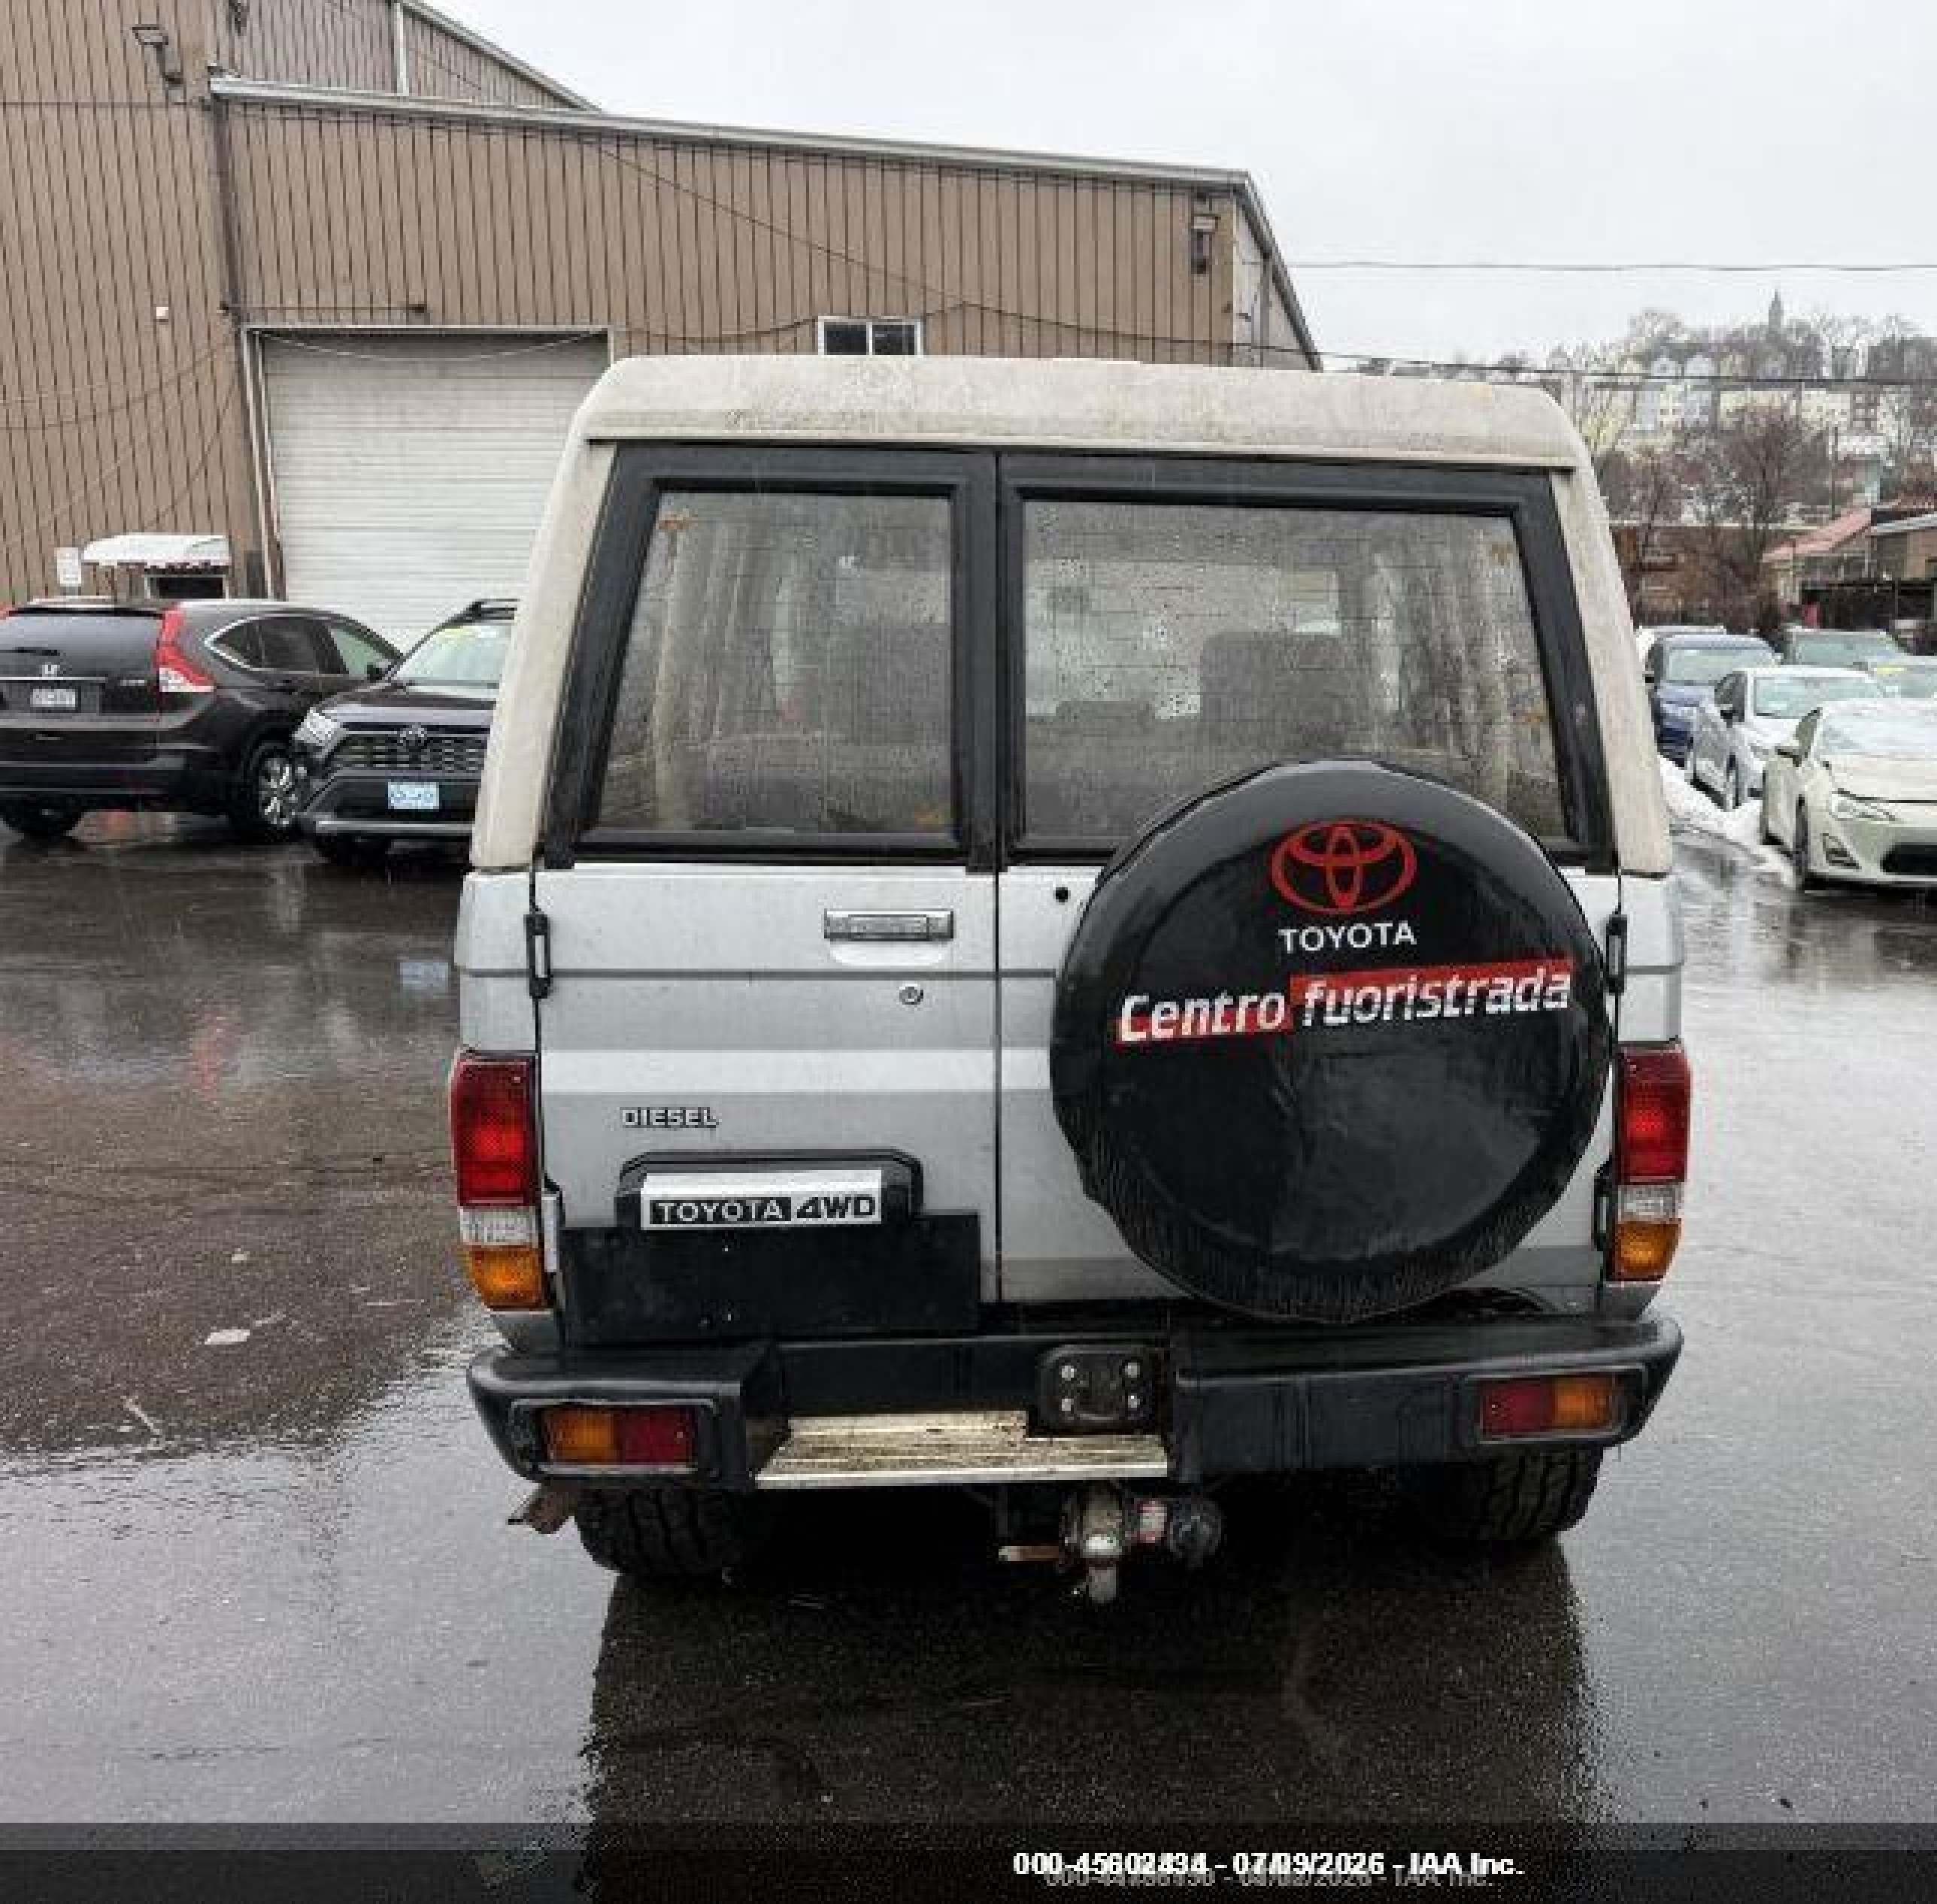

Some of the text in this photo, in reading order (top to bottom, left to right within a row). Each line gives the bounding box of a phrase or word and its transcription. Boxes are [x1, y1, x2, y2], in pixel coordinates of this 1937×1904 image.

[1280, 921, 1418, 954] TOYOTA
[1119, 967, 1572, 1044] Centro fuoristrada
[620, 1106, 719, 1128] DIESEL
[653, 1194, 878, 1223] TOYOTA 4WD
